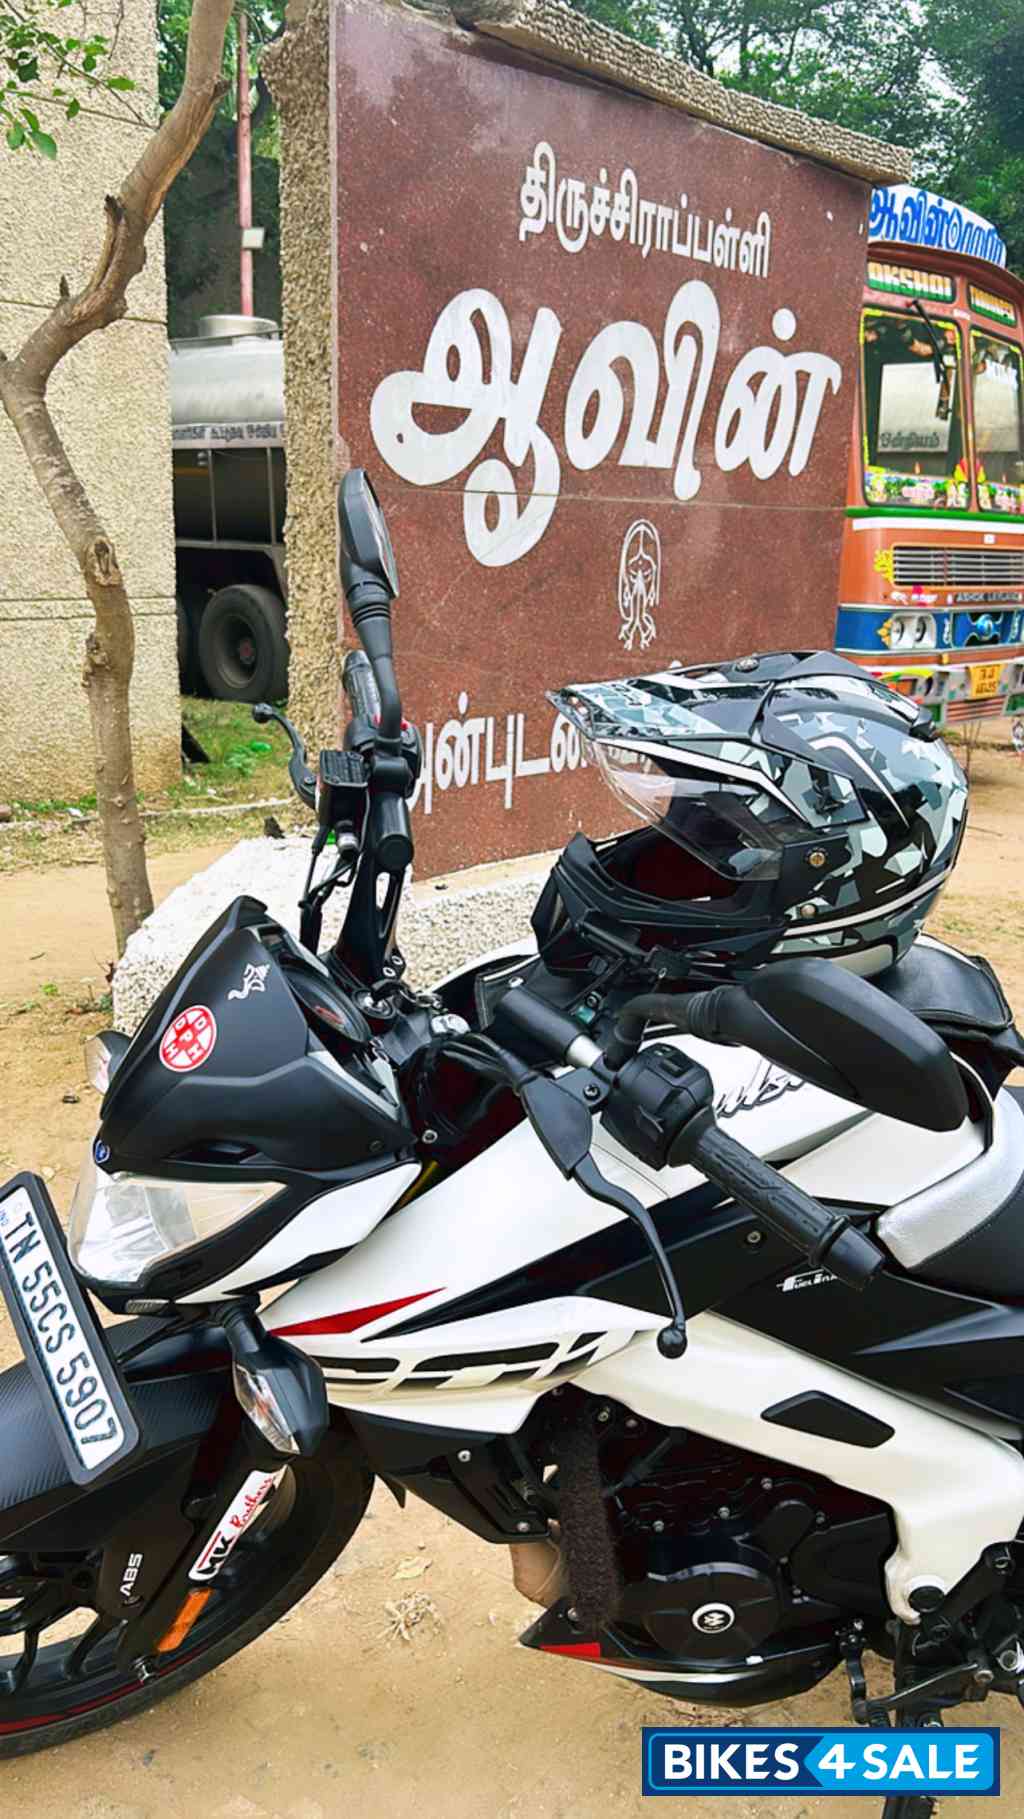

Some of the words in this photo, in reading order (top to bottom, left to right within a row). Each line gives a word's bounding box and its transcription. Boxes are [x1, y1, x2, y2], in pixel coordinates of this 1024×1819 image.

[519, 141, 771, 277] திருச்சிராப்பள்ளி
[369, 280, 842, 567] ஆவின்
[4, 1212, 41, 1264] TN
[21, 1260, 75, 1354] 55CS
[56, 1351, 118, 1445] 5907
[119, 1553, 143, 1597] ABS
